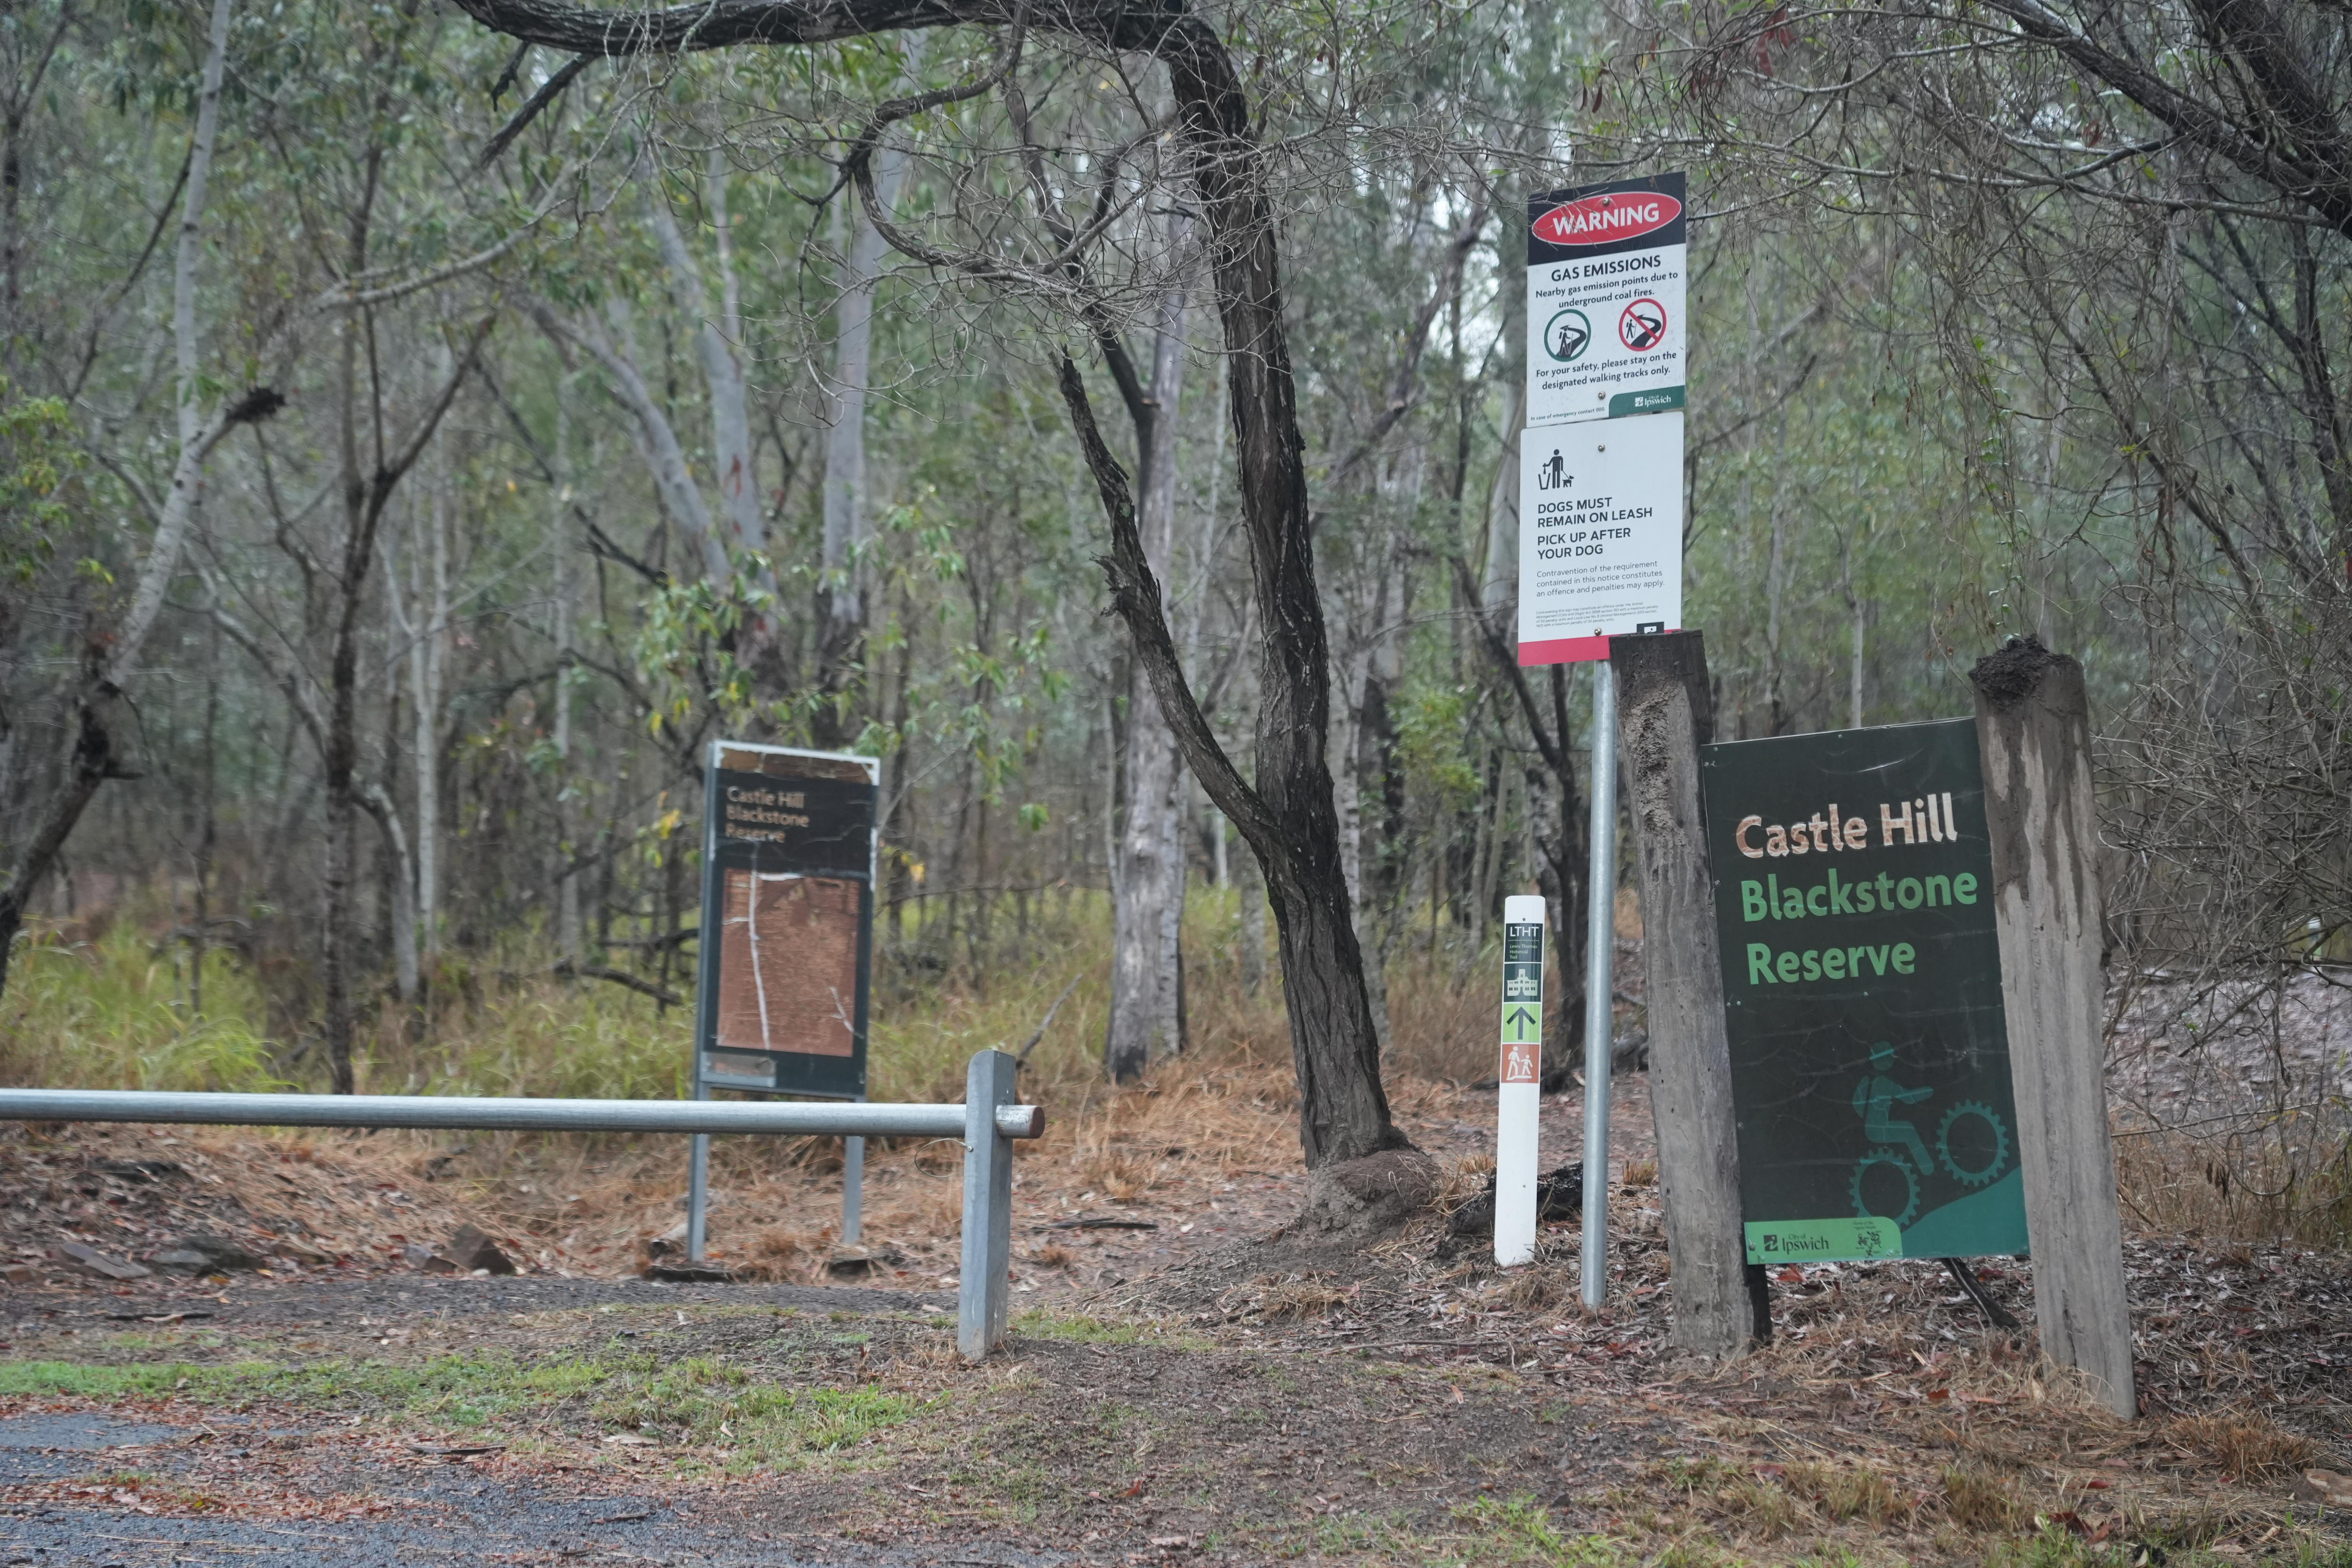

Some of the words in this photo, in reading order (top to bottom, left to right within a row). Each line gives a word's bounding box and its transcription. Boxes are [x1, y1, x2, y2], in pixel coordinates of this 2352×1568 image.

[1553, 203, 1659, 236] WARNING
[1551, 267, 1580, 281] GAS
[1584, 255, 1661, 278] EMISSIONS
[1536, 287, 1565, 298] Nearby
[1568, 286, 1581, 296] gas
[1583, 280, 1619, 291] emission
[1622, 276, 1648, 288] points
[1651, 272, 1666, 281] due
[1559, 292, 1612, 308] underground
[1614, 290, 1631, 300] coal
[1552, 367, 1570, 377] your
[1573, 363, 1599, 372] safety,
[1602, 359, 1628, 371] please
[1663, 351, 1677, 359] the
[1542, 375, 1587, 390] designated
[1589, 373, 1621, 383] walking
[1623, 368, 1648, 378] tracks
[1651, 365, 1670, 375] only.
[1645, 395, 1671, 407] Ipswich
[1538, 501, 1573, 514] DOGS
[1577, 497, 1612, 510] MUST
[1538, 514, 1585, 528] REMAIN
[1589, 511, 1608, 523] ON
[1612, 507, 1653, 520] LEASH
[1538, 534, 1565, 546] PICK
[1570, 532, 1586, 543] UP
[1591, 527, 1631, 541] AFTER
[1538, 548, 1572, 560] YOUR
[1576, 544, 1603, 556] DOG
[1537, 567, 1588, 577] Contravention
[1614, 561, 1657, 571] requirement
[1537, 578, 1572, 587] contained
[1622, 571, 1663, 579] constitutes
[1592, 583, 1625, 594] penalties
[1644, 580, 1665, 589] apply.
[726, 785, 775, 806] Castle
[778, 790, 805, 809] Hill
[726, 804, 810, 828] Blackstone
[1736, 804, 1867, 859] Castle
[1880, 792, 1958, 846] Hill
[1740, 868, 1978, 923] Blackstone
[1510, 926, 1539, 937] LTHT
[1747, 942, 1916, 985] Reserve
[1782, 1236, 1829, 1255] Ipswich
